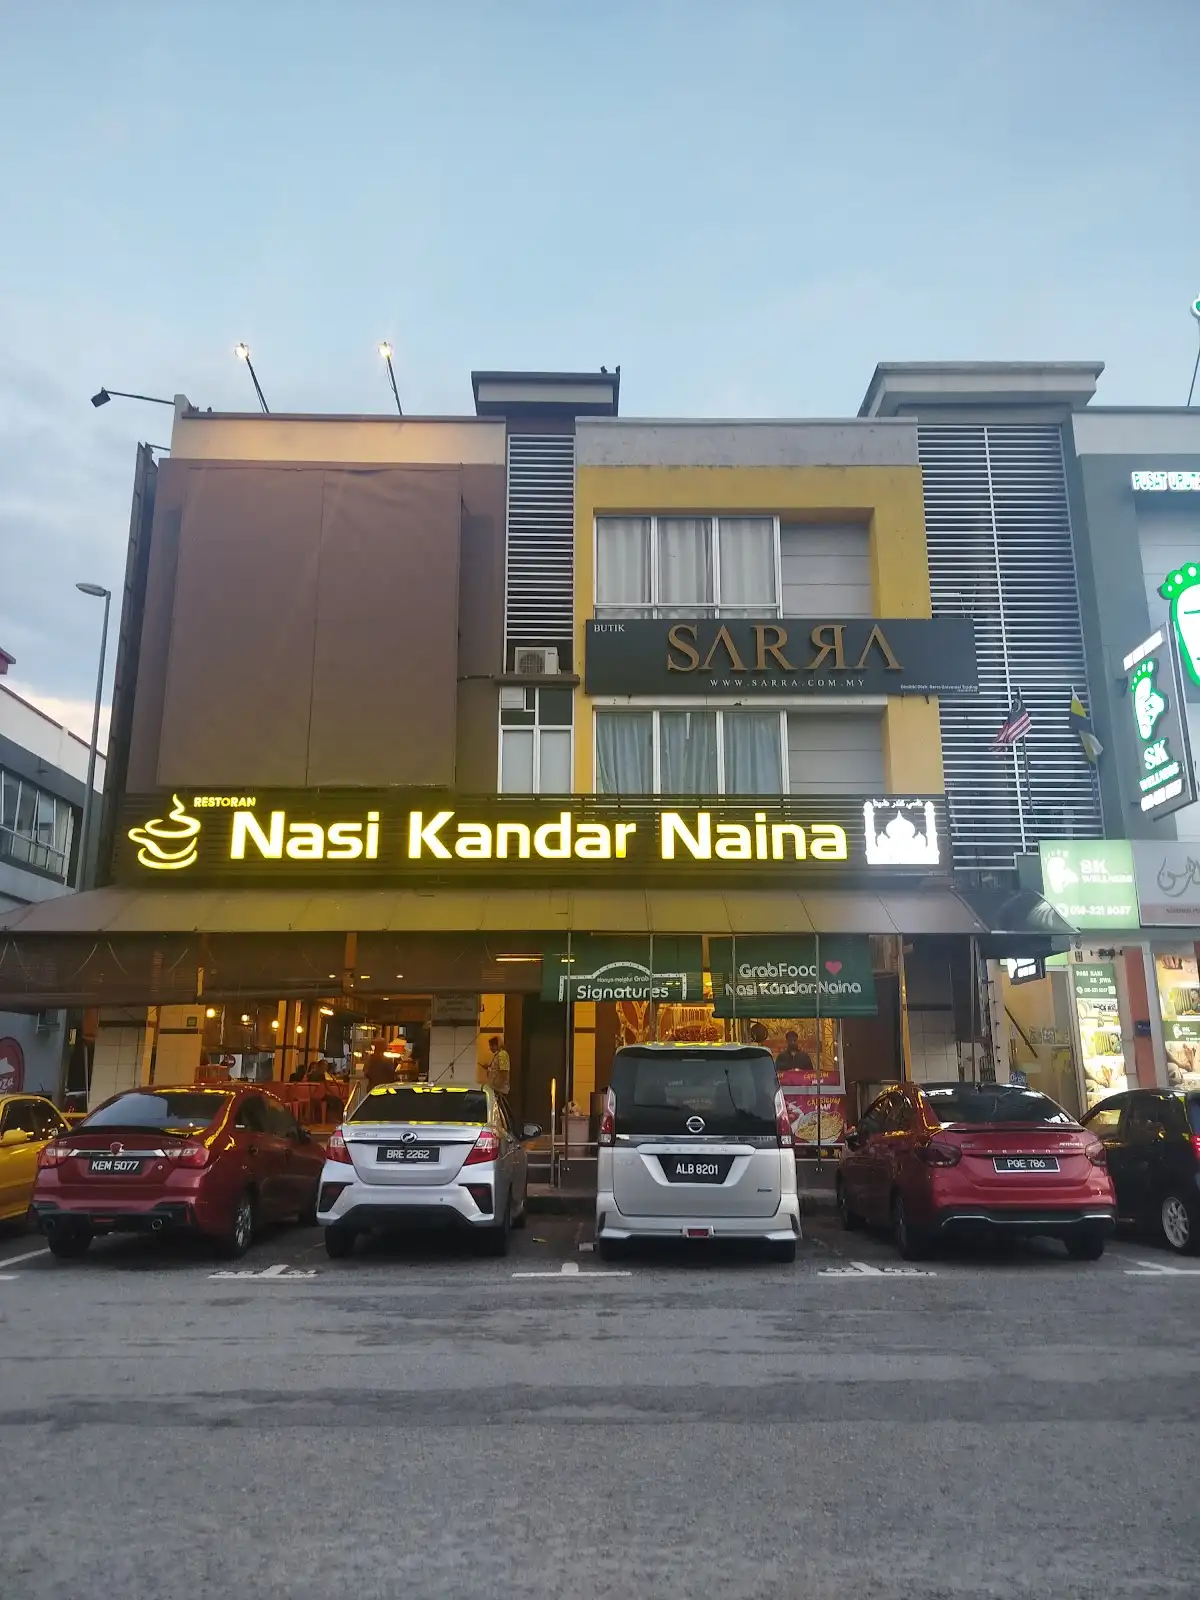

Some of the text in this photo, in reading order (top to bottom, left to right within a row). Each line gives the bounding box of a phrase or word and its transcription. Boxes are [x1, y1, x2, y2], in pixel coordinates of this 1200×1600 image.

[1168, 471, 1200, 491] URUT
[594, 624, 625, 632] BUTIK
[193, 796, 256, 808] RESTORAN
[230, 811, 848, 860] Nasi Kandar Naina
[633, 974, 650, 982] Grab
[818, 980, 862, 993] Naina
[576, 985, 669, 1001] Signatures
[386, 1149, 430, 1159] BRE 2262
[91, 1160, 140, 1171] KEM 5077
[676, 1163, 719, 1175] ALB 8201
[1007, 1159, 1045, 1168] PGE 786
